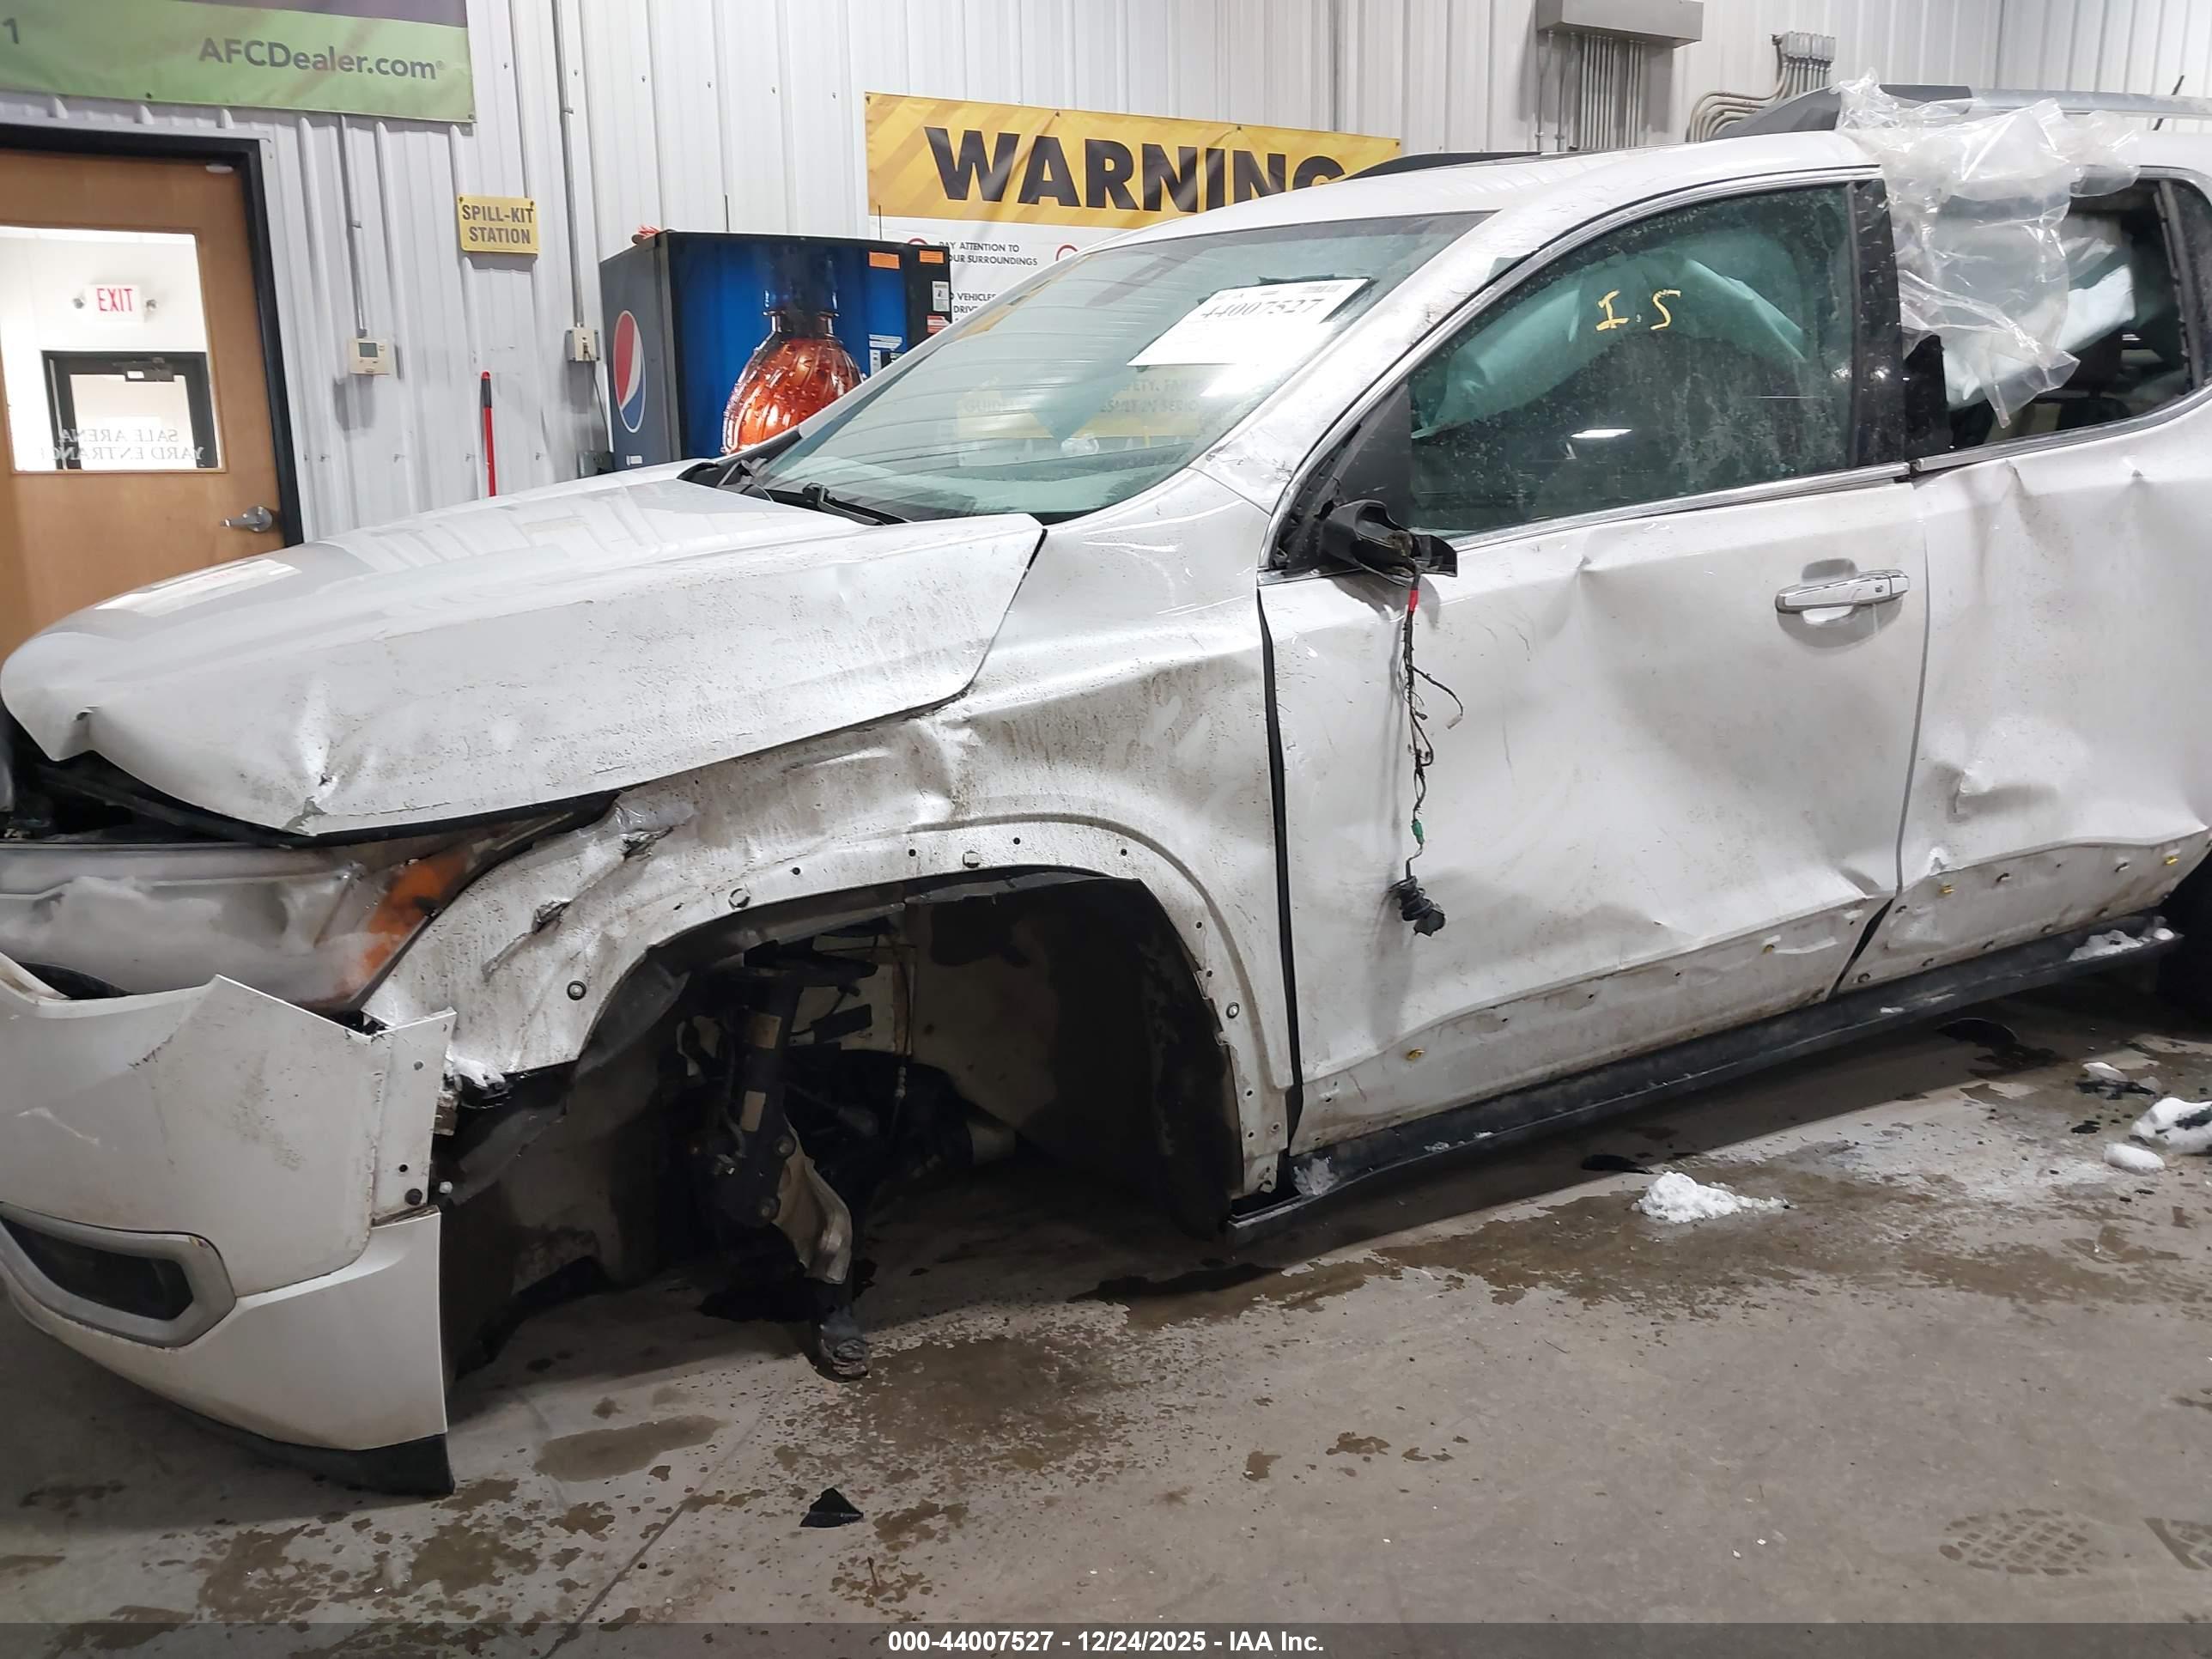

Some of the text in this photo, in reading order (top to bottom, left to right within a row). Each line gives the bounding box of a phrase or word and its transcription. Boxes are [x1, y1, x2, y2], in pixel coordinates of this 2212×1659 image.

[462, 204, 534, 223] SPILL-KIT
[469, 226, 531, 244] STATION
[960, 242, 1006, 252] ATTENTION
[949, 254, 965, 263] OUR
[968, 255, 1037, 265] SURROUNDINGS
[97, 288, 132, 312] EXIT
[954, 305, 978, 313] DRIV
